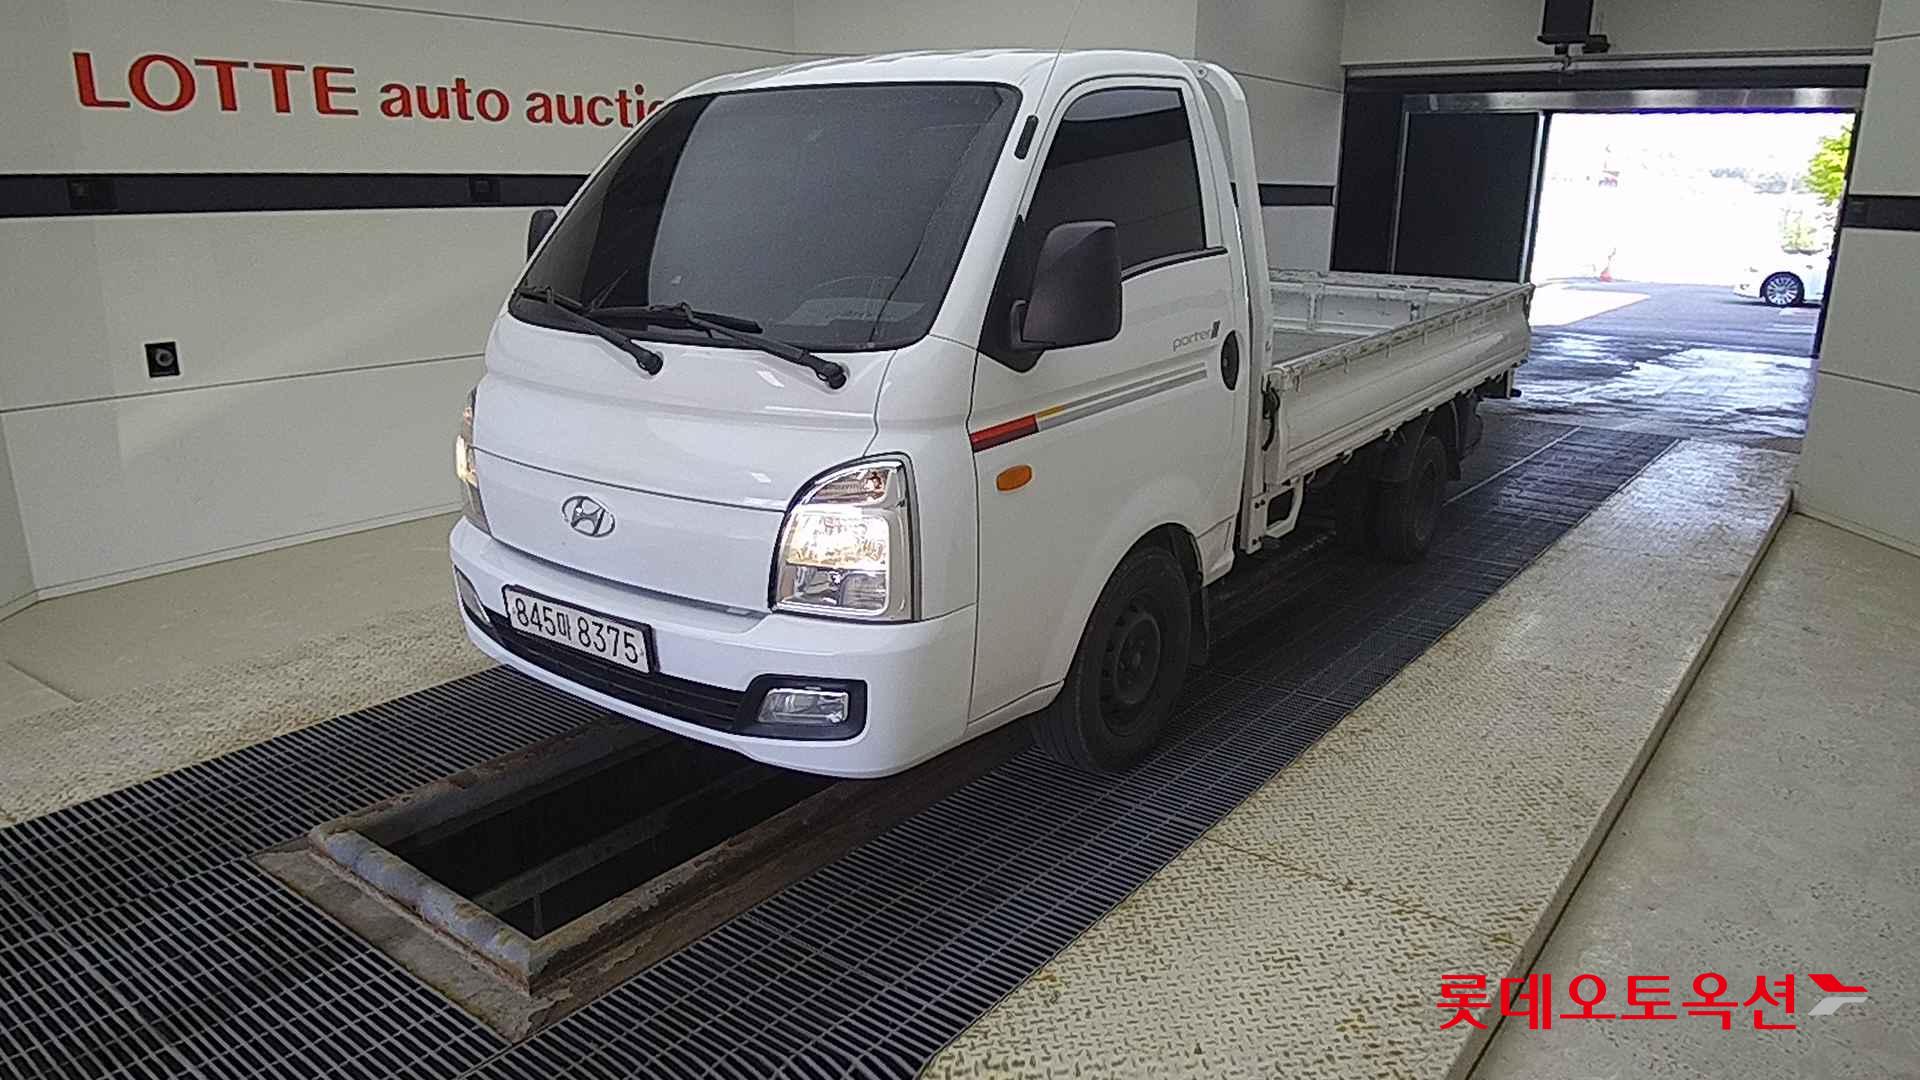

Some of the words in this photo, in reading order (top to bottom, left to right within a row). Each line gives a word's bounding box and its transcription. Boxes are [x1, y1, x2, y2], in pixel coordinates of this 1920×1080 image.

[73, 51, 359, 116] LOTTE
[379, 78, 510, 122] auto
[526, 84, 665, 128] aucti
[577, 616, 638, 664] 8375
